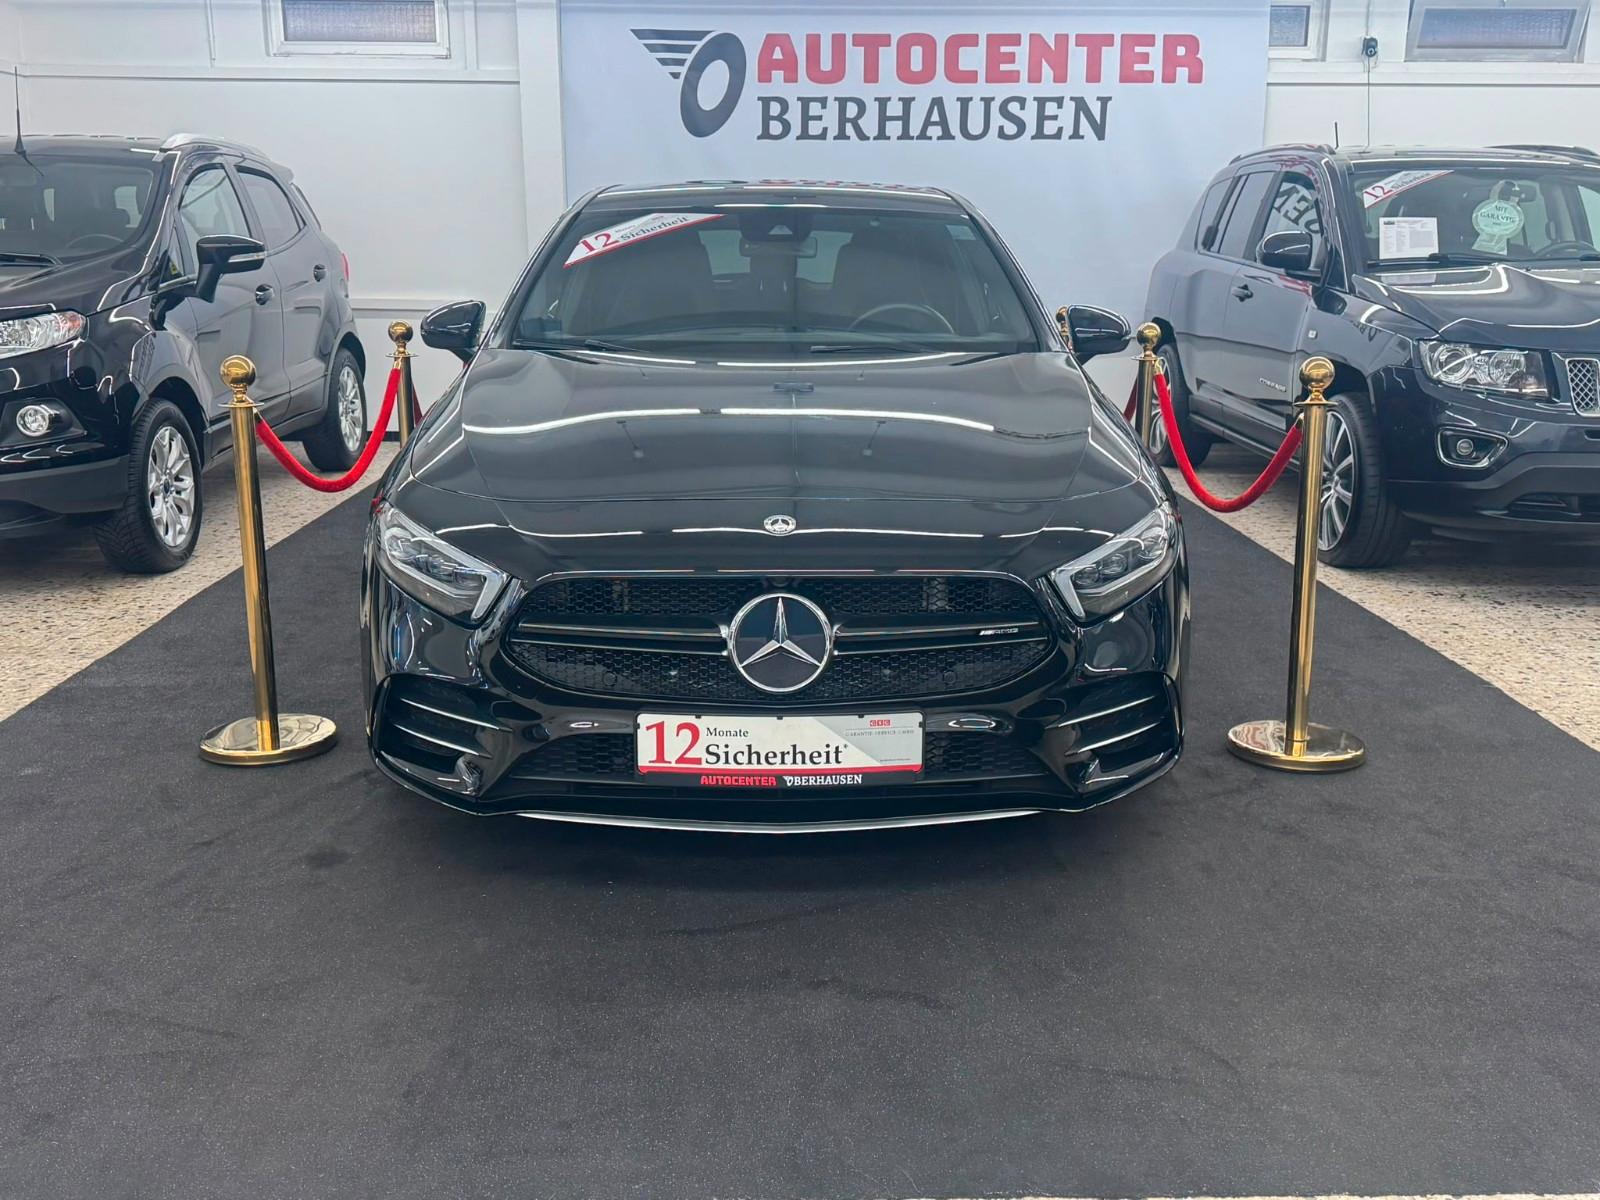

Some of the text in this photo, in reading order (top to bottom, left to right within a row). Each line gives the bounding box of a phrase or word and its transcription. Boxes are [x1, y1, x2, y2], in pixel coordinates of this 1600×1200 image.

[757, 32, 1204, 84] AUTOCENTER
[580, 232, 620, 254] 12
[645, 720, 702, 766] 12
[706, 727, 749, 738] Monate
[700, 776, 777, 786] AUTOCENTER
